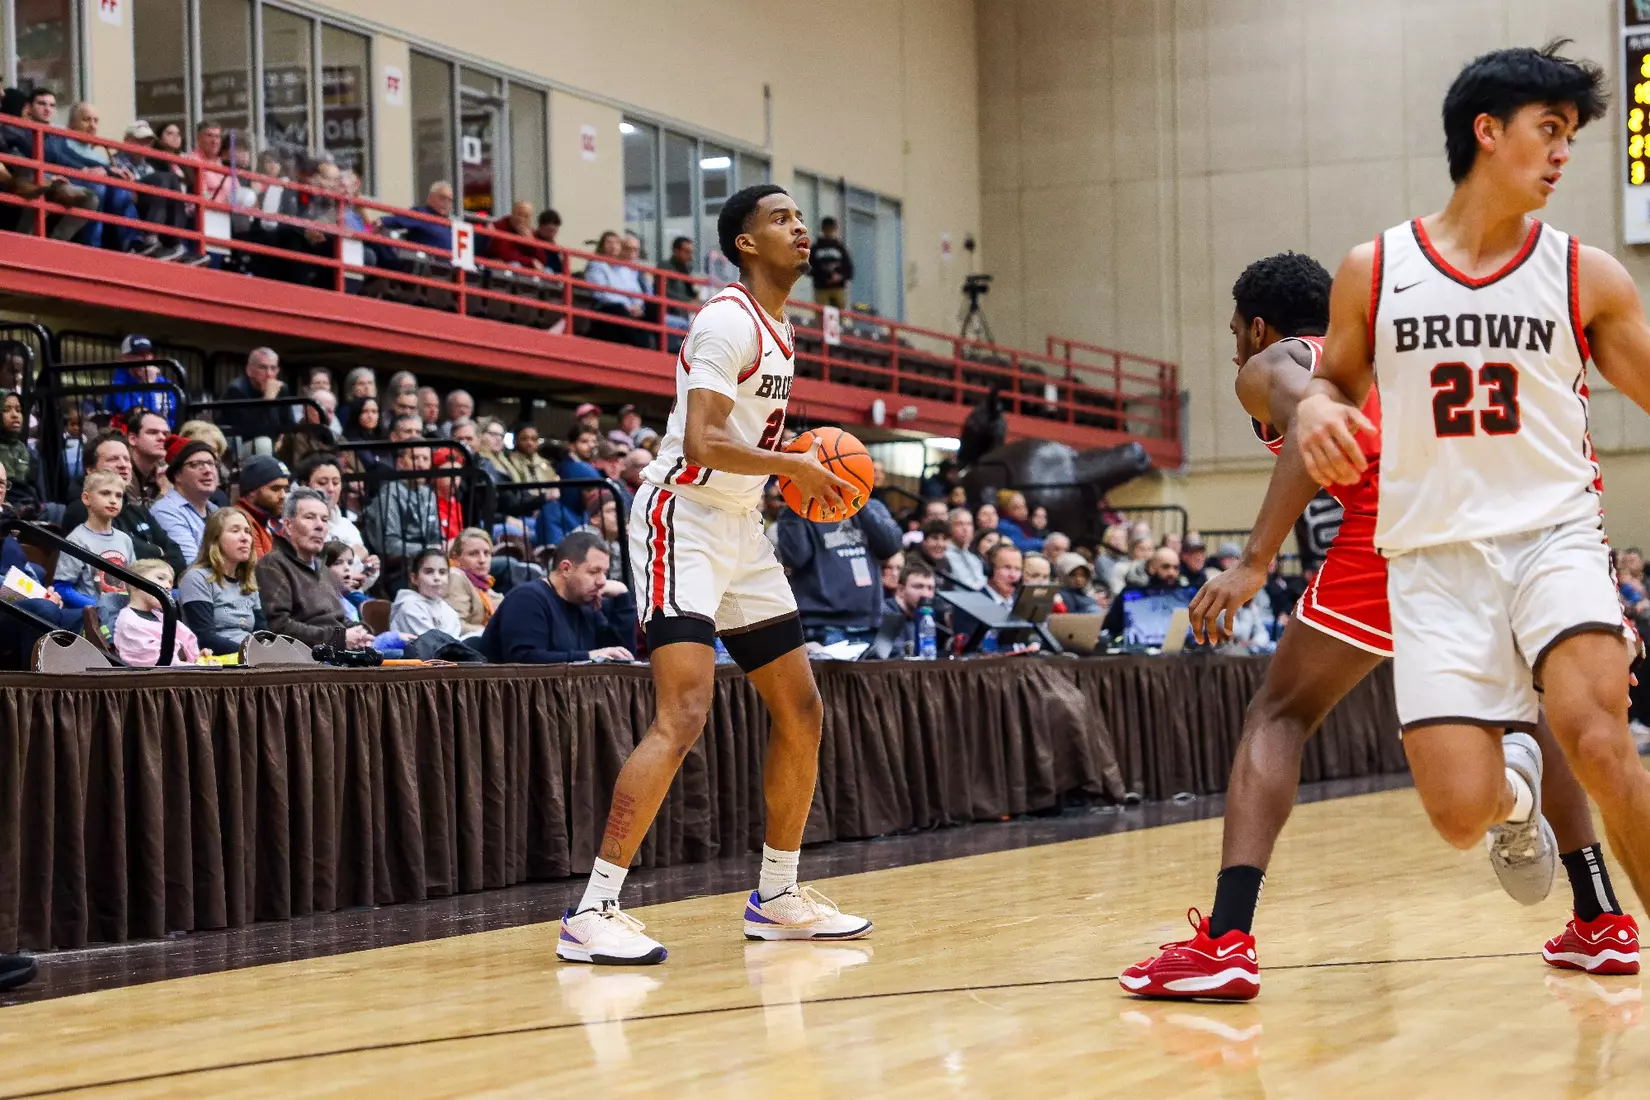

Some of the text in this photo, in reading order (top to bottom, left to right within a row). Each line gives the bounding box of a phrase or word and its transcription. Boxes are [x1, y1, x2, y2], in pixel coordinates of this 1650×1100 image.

[457, 230, 469, 258] F
[1393, 313, 1556, 355] BROWN
[755, 374, 793, 400] BRO
[1430, 361, 1521, 438] 23
[756, 408, 784, 452] 2
